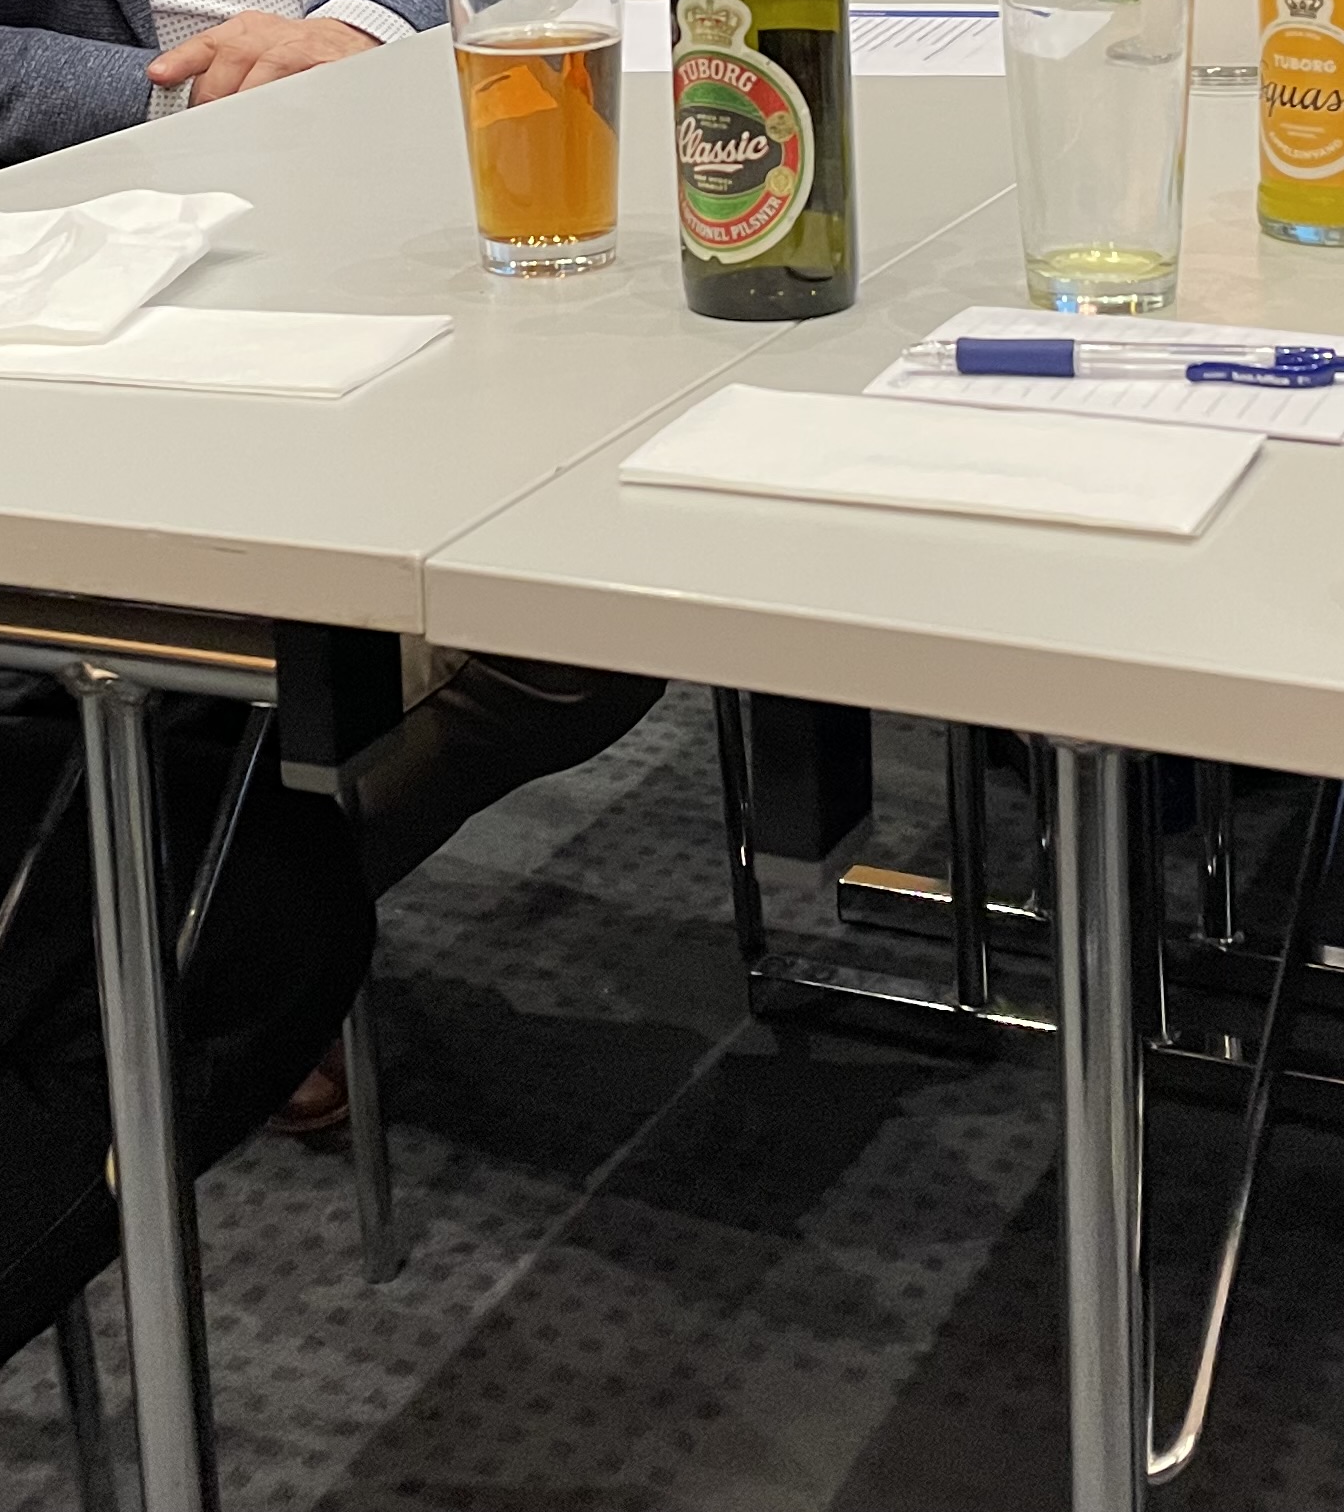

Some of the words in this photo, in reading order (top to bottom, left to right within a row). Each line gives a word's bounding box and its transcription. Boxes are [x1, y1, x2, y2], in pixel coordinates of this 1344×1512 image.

[678, 58, 758, 92] TUBORG
[1274, 54, 1337, 74] TUBORG
[678, 116, 770, 164] Classic
[730, 196, 783, 240] PILSNER
